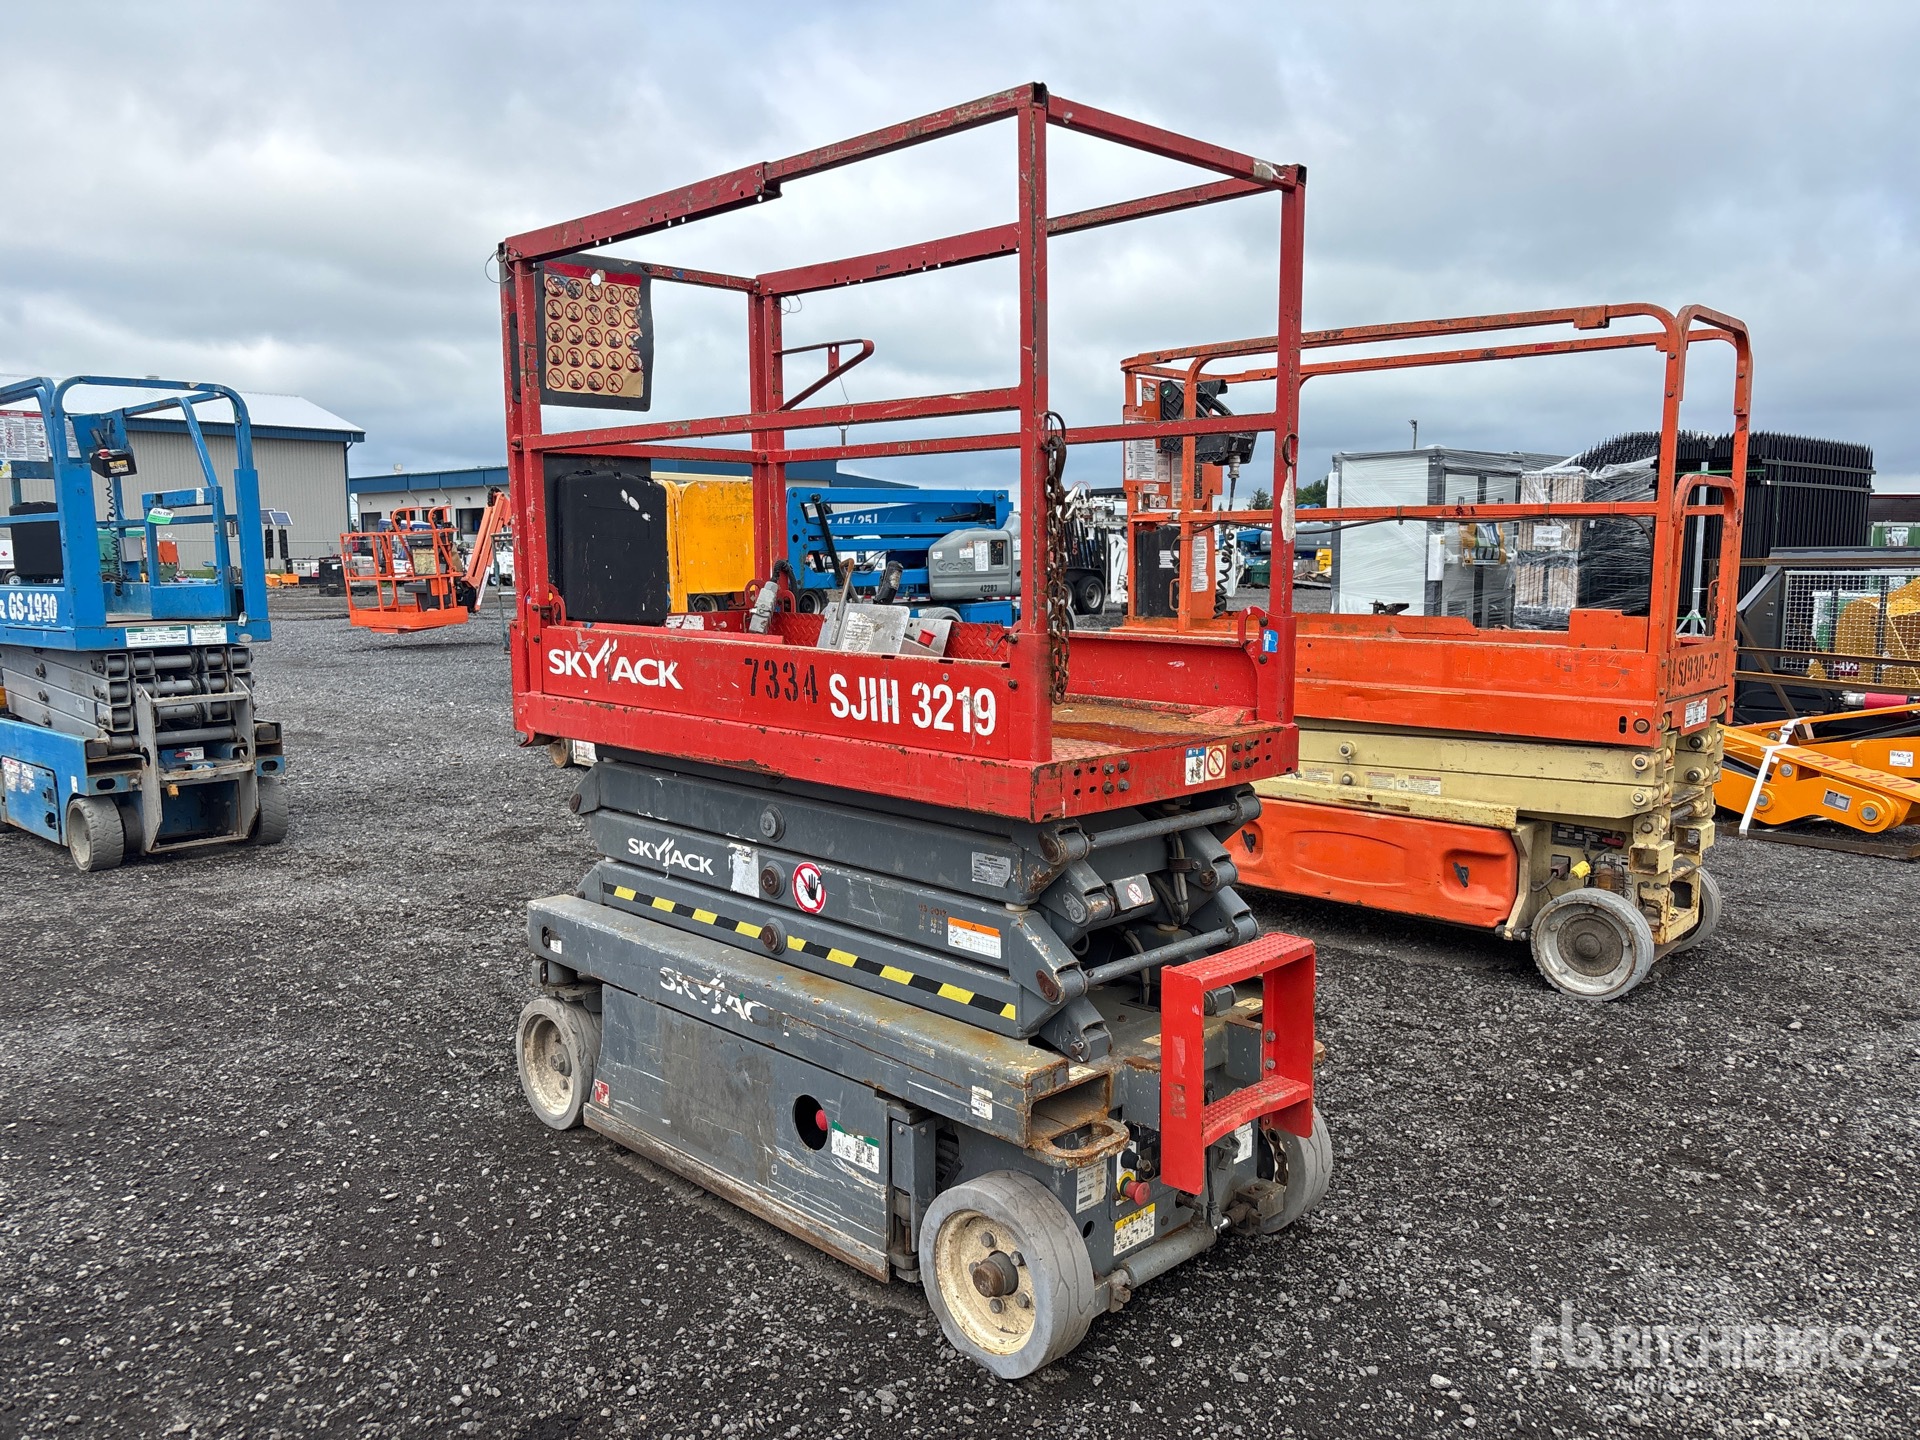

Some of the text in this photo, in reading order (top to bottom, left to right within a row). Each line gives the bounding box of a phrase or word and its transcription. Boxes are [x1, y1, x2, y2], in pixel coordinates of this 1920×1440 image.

[935, 558, 974, 572] Genie
[8, 591, 58, 623] GS-1930
[745, 657, 819, 704] 7334
[911, 681, 997, 737] 3219
[1797, 754, 1917, 789] CAT 320
[628, 836, 714, 876] SKYJACK
